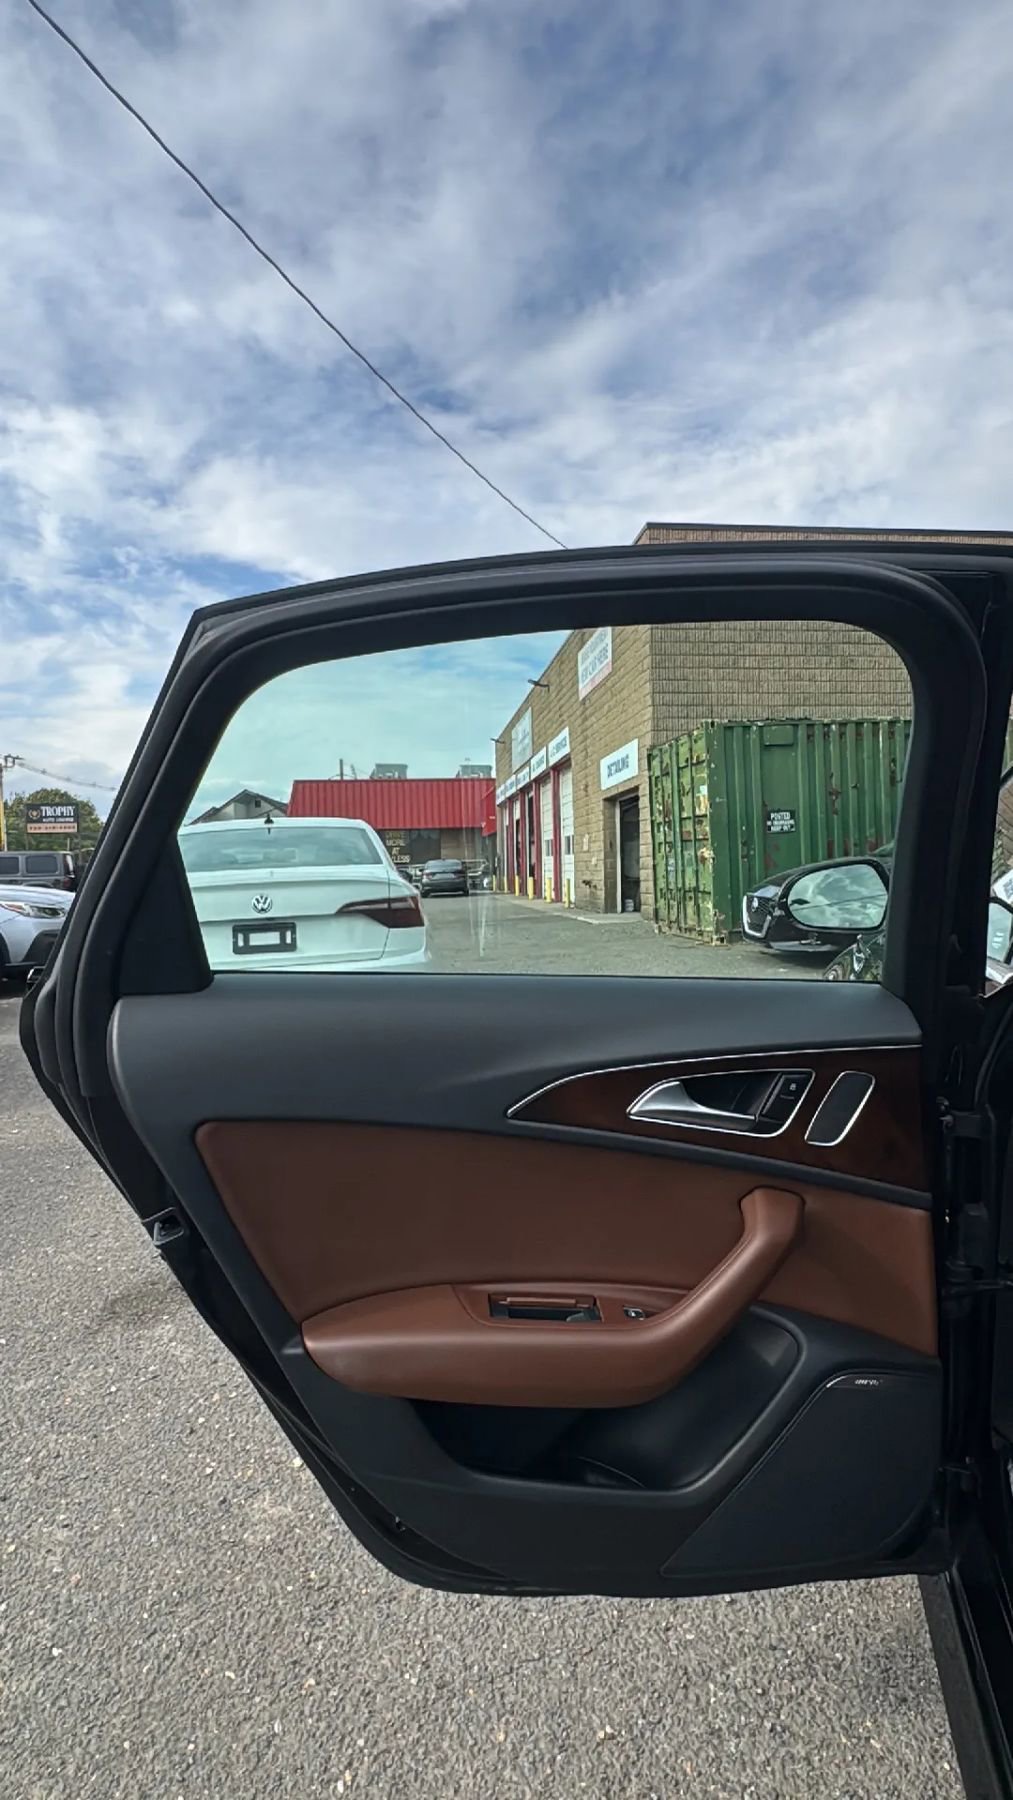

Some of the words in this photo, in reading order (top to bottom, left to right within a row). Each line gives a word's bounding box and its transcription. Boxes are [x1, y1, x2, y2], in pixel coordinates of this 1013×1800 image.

[607, 753, 629, 779] DETAILING
[41, 805, 75, 817] TROPHY
[770, 811, 790, 820] POSTED
[392, 847, 400, 855] AT
